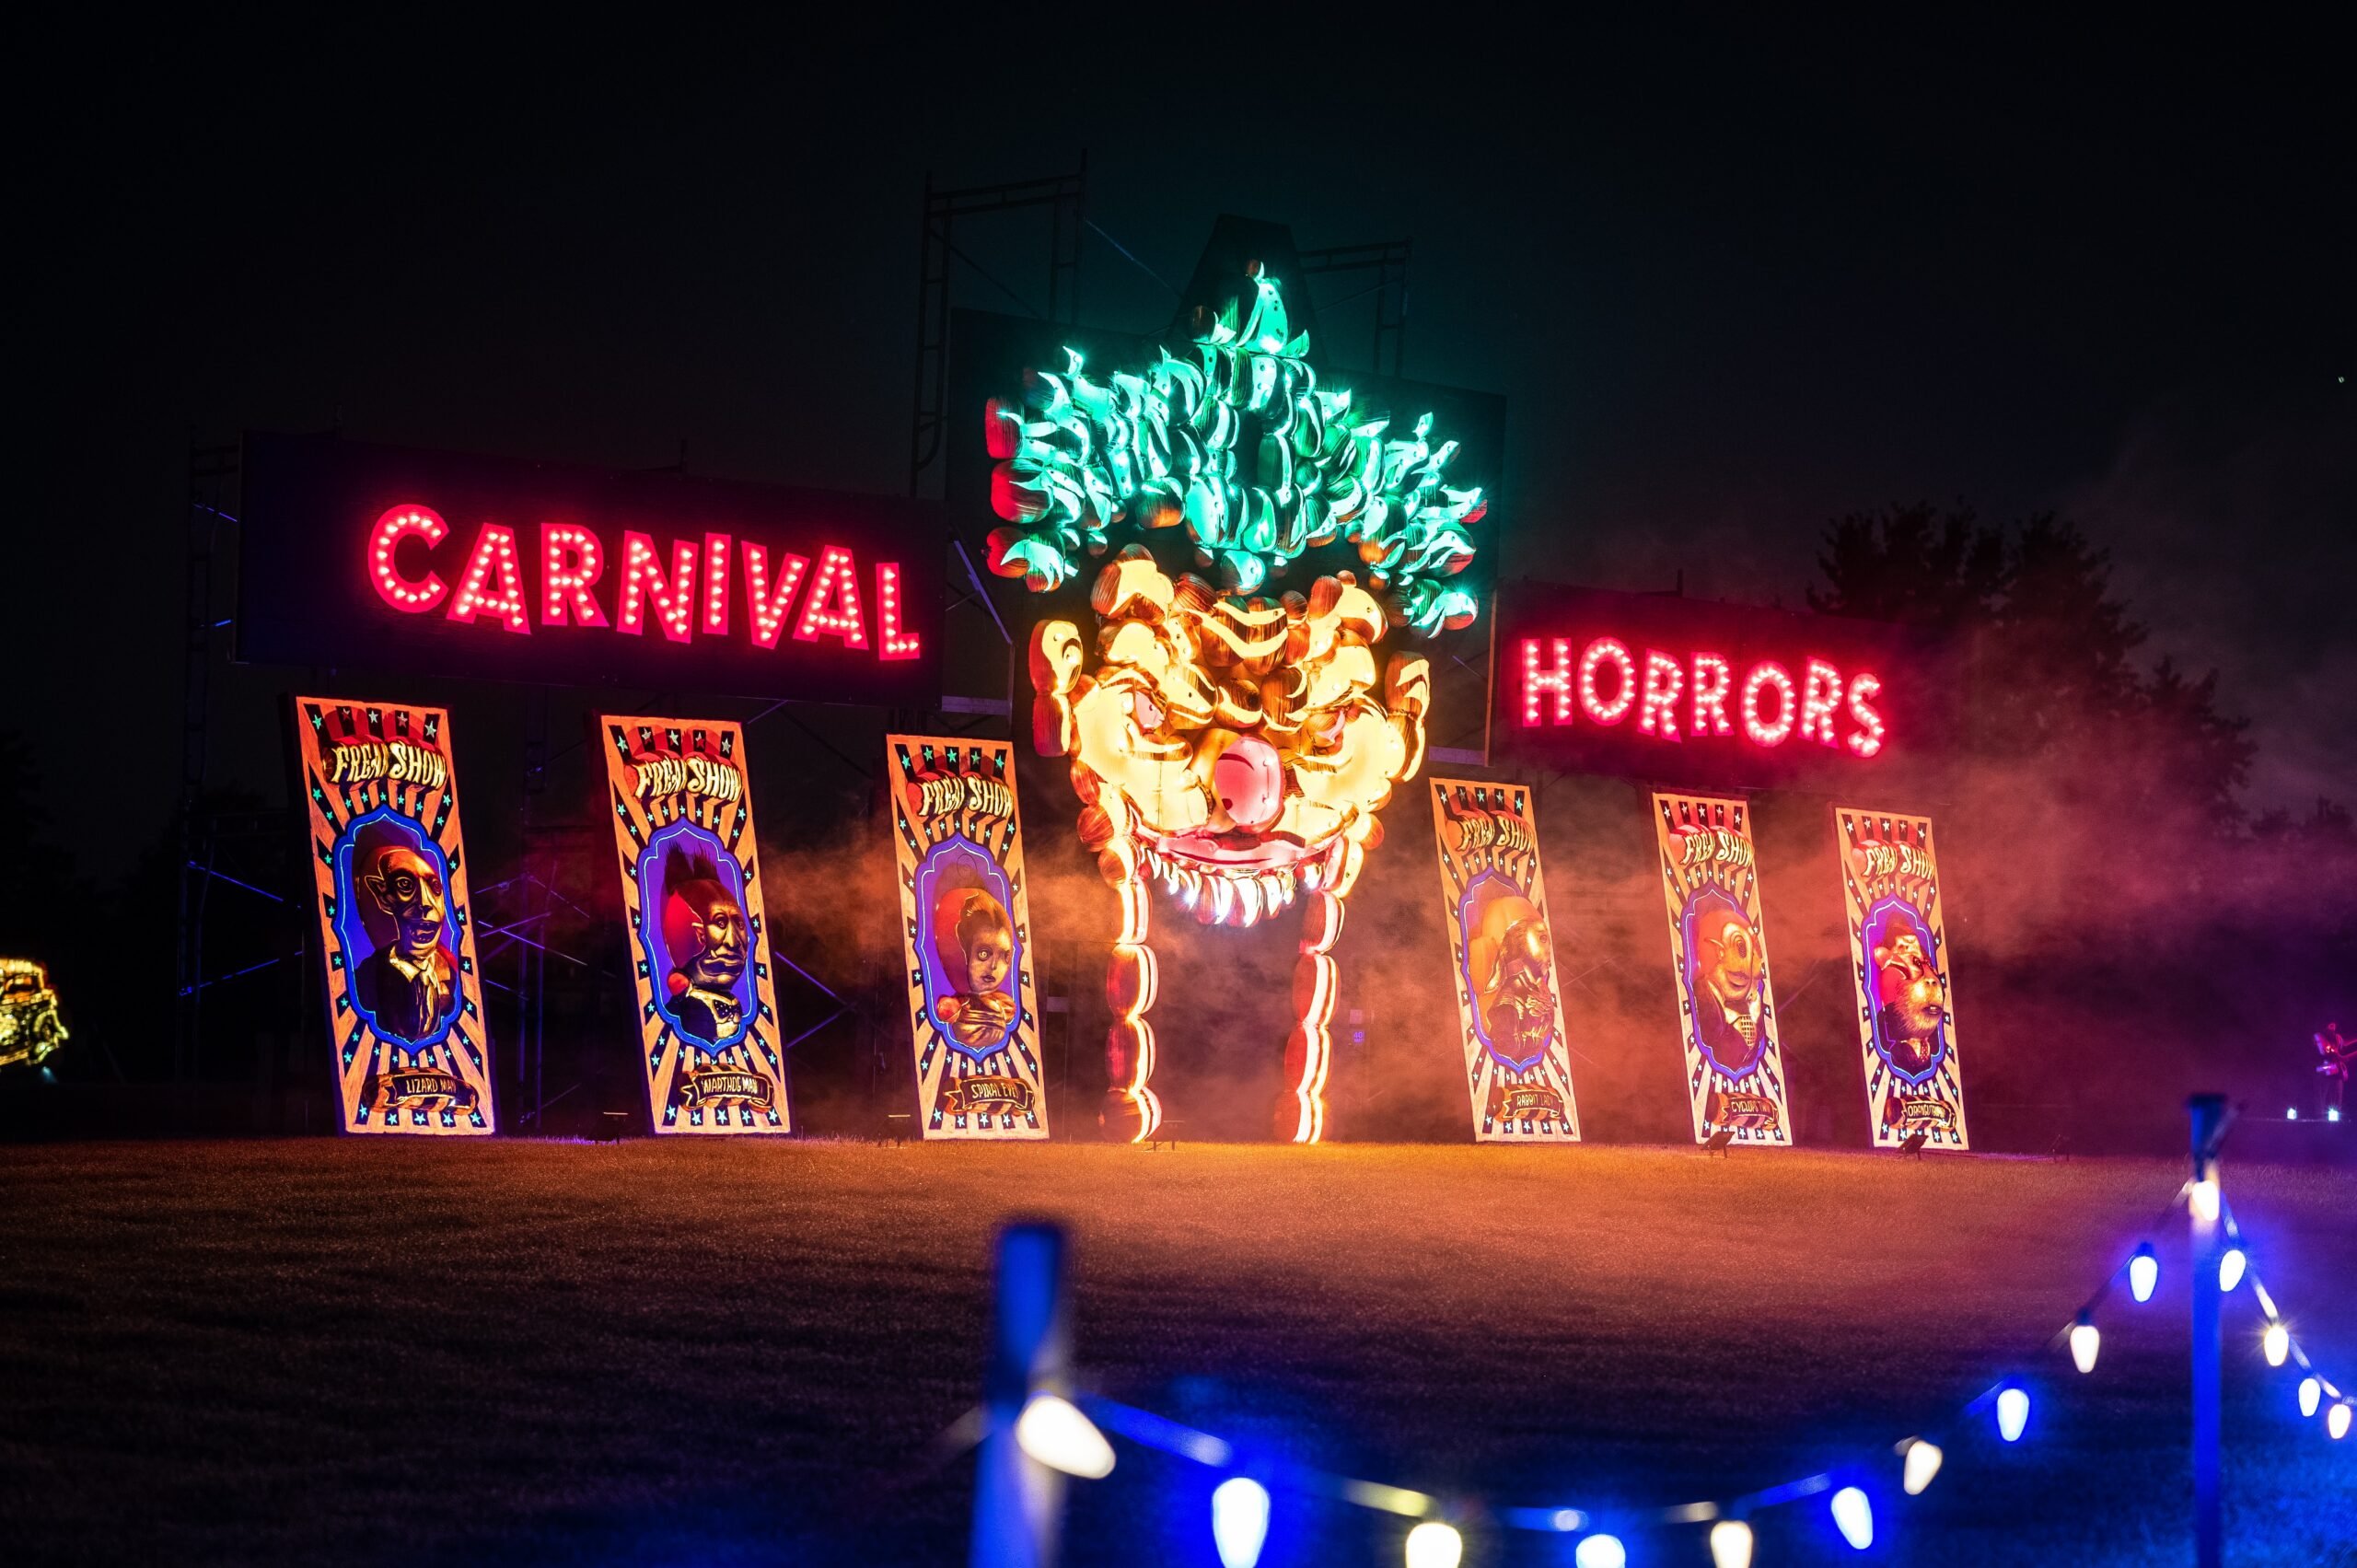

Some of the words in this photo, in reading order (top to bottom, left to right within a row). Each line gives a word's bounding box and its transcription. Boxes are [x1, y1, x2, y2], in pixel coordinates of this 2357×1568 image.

[368, 504, 920, 660] CARNIVAL
[1521, 636, 1885, 759] HORRORS
[389, 740, 447, 790] SHOW
[686, 756, 743, 802] SHOW
[1459, 816, 1495, 851] FREA
[1680, 829, 1716, 865] FREA
[1862, 845, 1898, 877] FREA
[406, 1078, 438, 1093] LIZARD
[441, 1079, 457, 1094] MAN
[702, 1076, 741, 1095] WARTHOG
[742, 1078, 758, 1094] MAN
[971, 1082, 1002, 1098] SPIRAL
[1516, 1094, 1538, 1107] RABBIT
